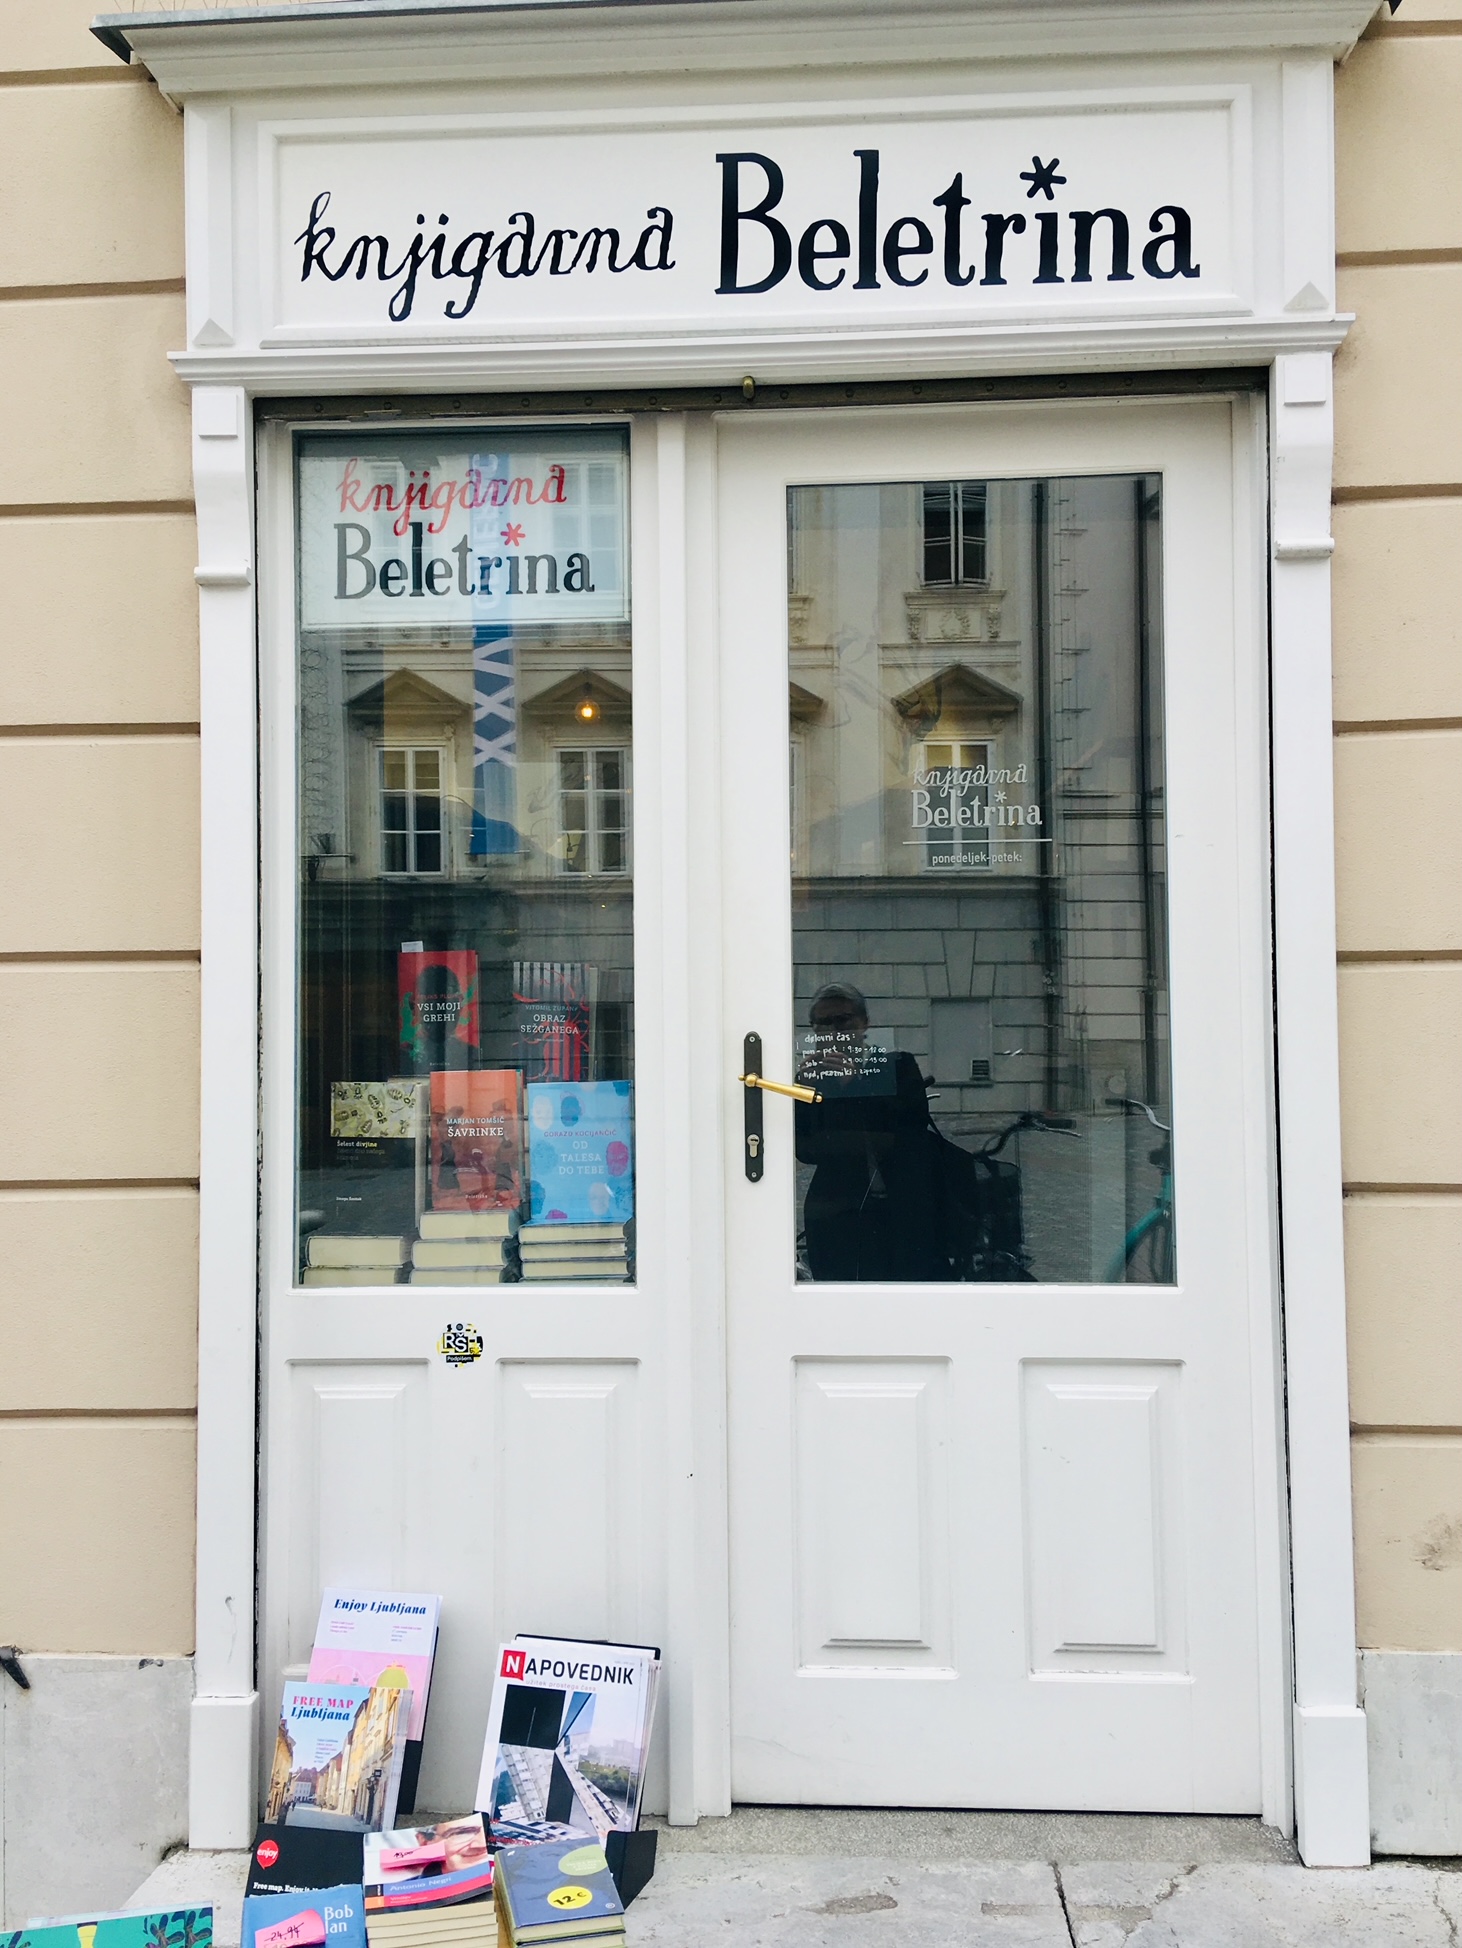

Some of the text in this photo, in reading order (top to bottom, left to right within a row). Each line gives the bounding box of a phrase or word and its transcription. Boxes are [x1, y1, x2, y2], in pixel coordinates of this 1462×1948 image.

[294, 149, 1200, 322] knjigarna Beletrina
[336, 458, 567, 537] knjigarna
[334, 521, 595, 600] Beletrina
[913, 761, 1028, 798] knjigarna
[911, 789, 1043, 828] Beletrina
[417, 1002, 461, 1011] VSI MOJI
[423, 1013, 455, 1022] GREHI
[533, 1014, 566, 1023] OBRAZ
[520, 1023, 579, 1034] SEŽGANEGA
[446, 1117, 475, 1125] MARJAN
[447, 1126, 504, 1137] ŠAVRINKE
[572, 1140, 589, 1150] OD
[560, 1153, 602, 1162] TALESA
[558, 1165, 605, 1175] DO TEBE
[334, 1598, 427, 1616] Enjoy Ljubljana
[506, 1655, 635, 1685] NAPOVEDNIK
[293, 1695, 354, 1709] FREE MAP
[291, 1706, 351, 1722] Ljubljana
[257, 1848, 279, 1860] enjoy
[252, 1881, 268, 1890] Free
[389, 1882, 426, 1891] Antonio
[428, 1876, 452, 1886] Negri
[553, 1895, 576, 1906] 12
[324, 1904, 354, 1920] Bob
